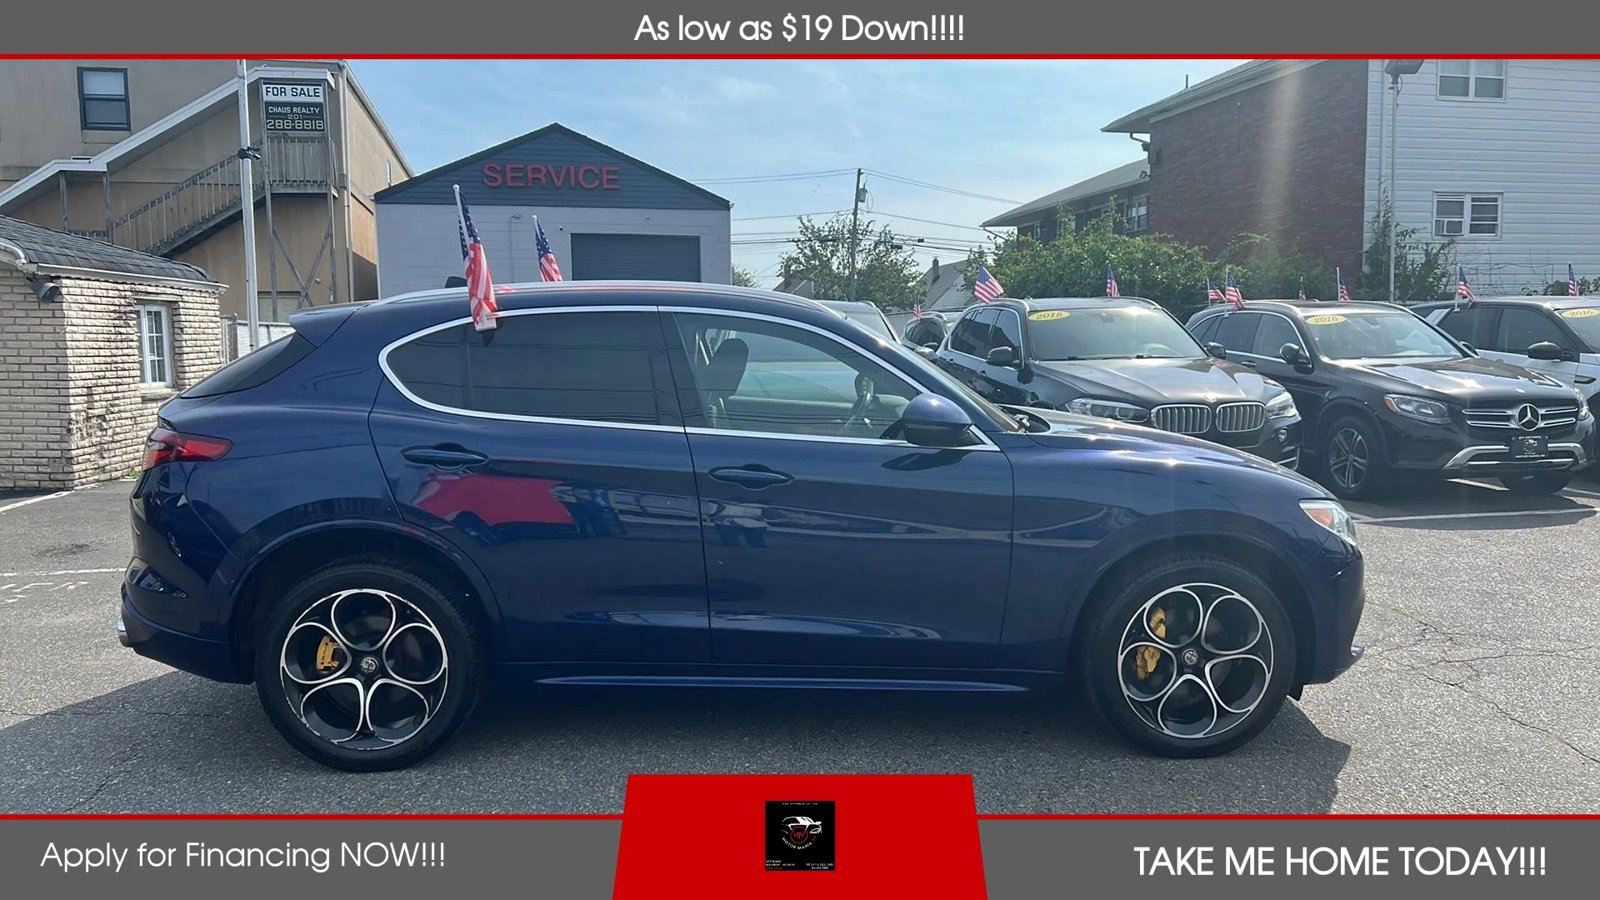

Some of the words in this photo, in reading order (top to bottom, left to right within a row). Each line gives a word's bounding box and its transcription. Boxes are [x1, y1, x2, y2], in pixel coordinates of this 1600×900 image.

[265, 86, 287, 97] FOR
[291, 87, 321, 98] SALE
[293, 106, 320, 114] REALTY
[482, 162, 620, 190] SERVICE
